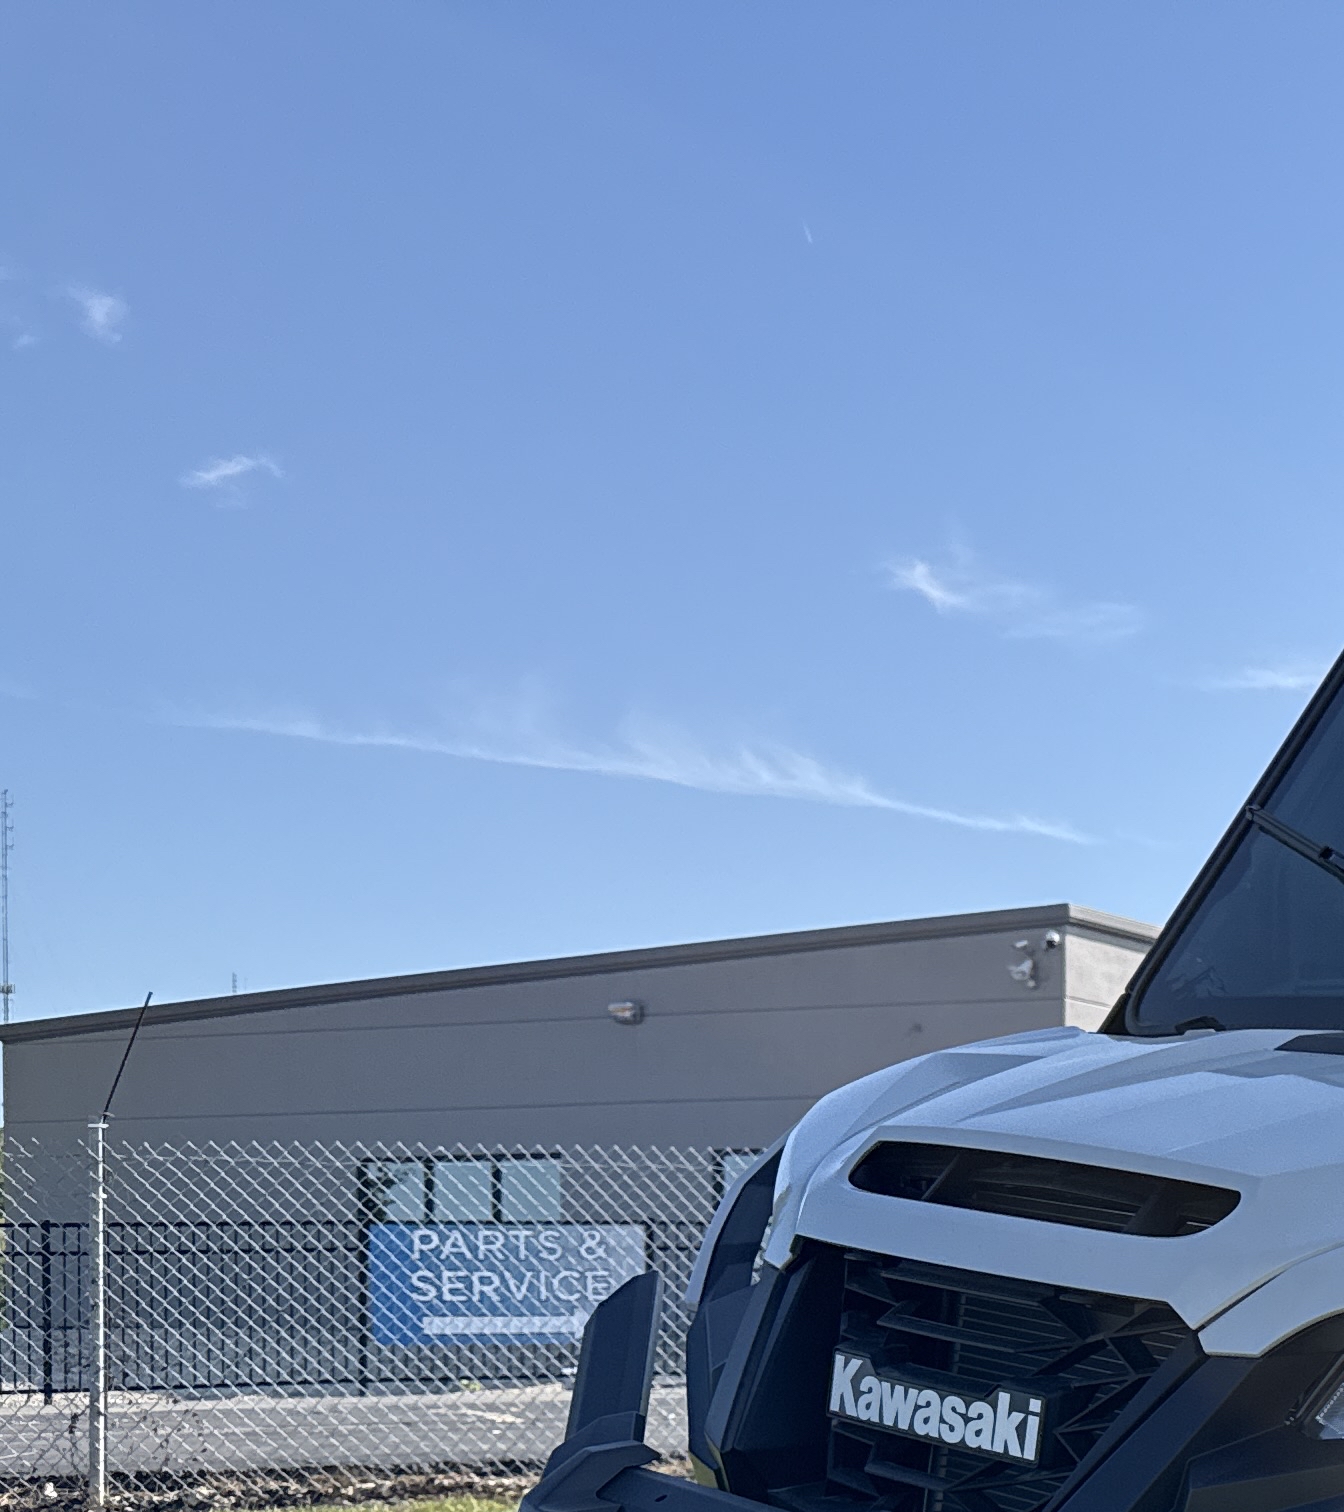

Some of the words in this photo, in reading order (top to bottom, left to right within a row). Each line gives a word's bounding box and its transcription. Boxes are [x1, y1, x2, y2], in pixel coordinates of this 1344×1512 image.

[410, 1230, 562, 1261] PARTS
[579, 1230, 608, 1260] &
[410, 1270, 613, 1301] SERVICE
[829, 1351, 1042, 1461] Kawasaki
